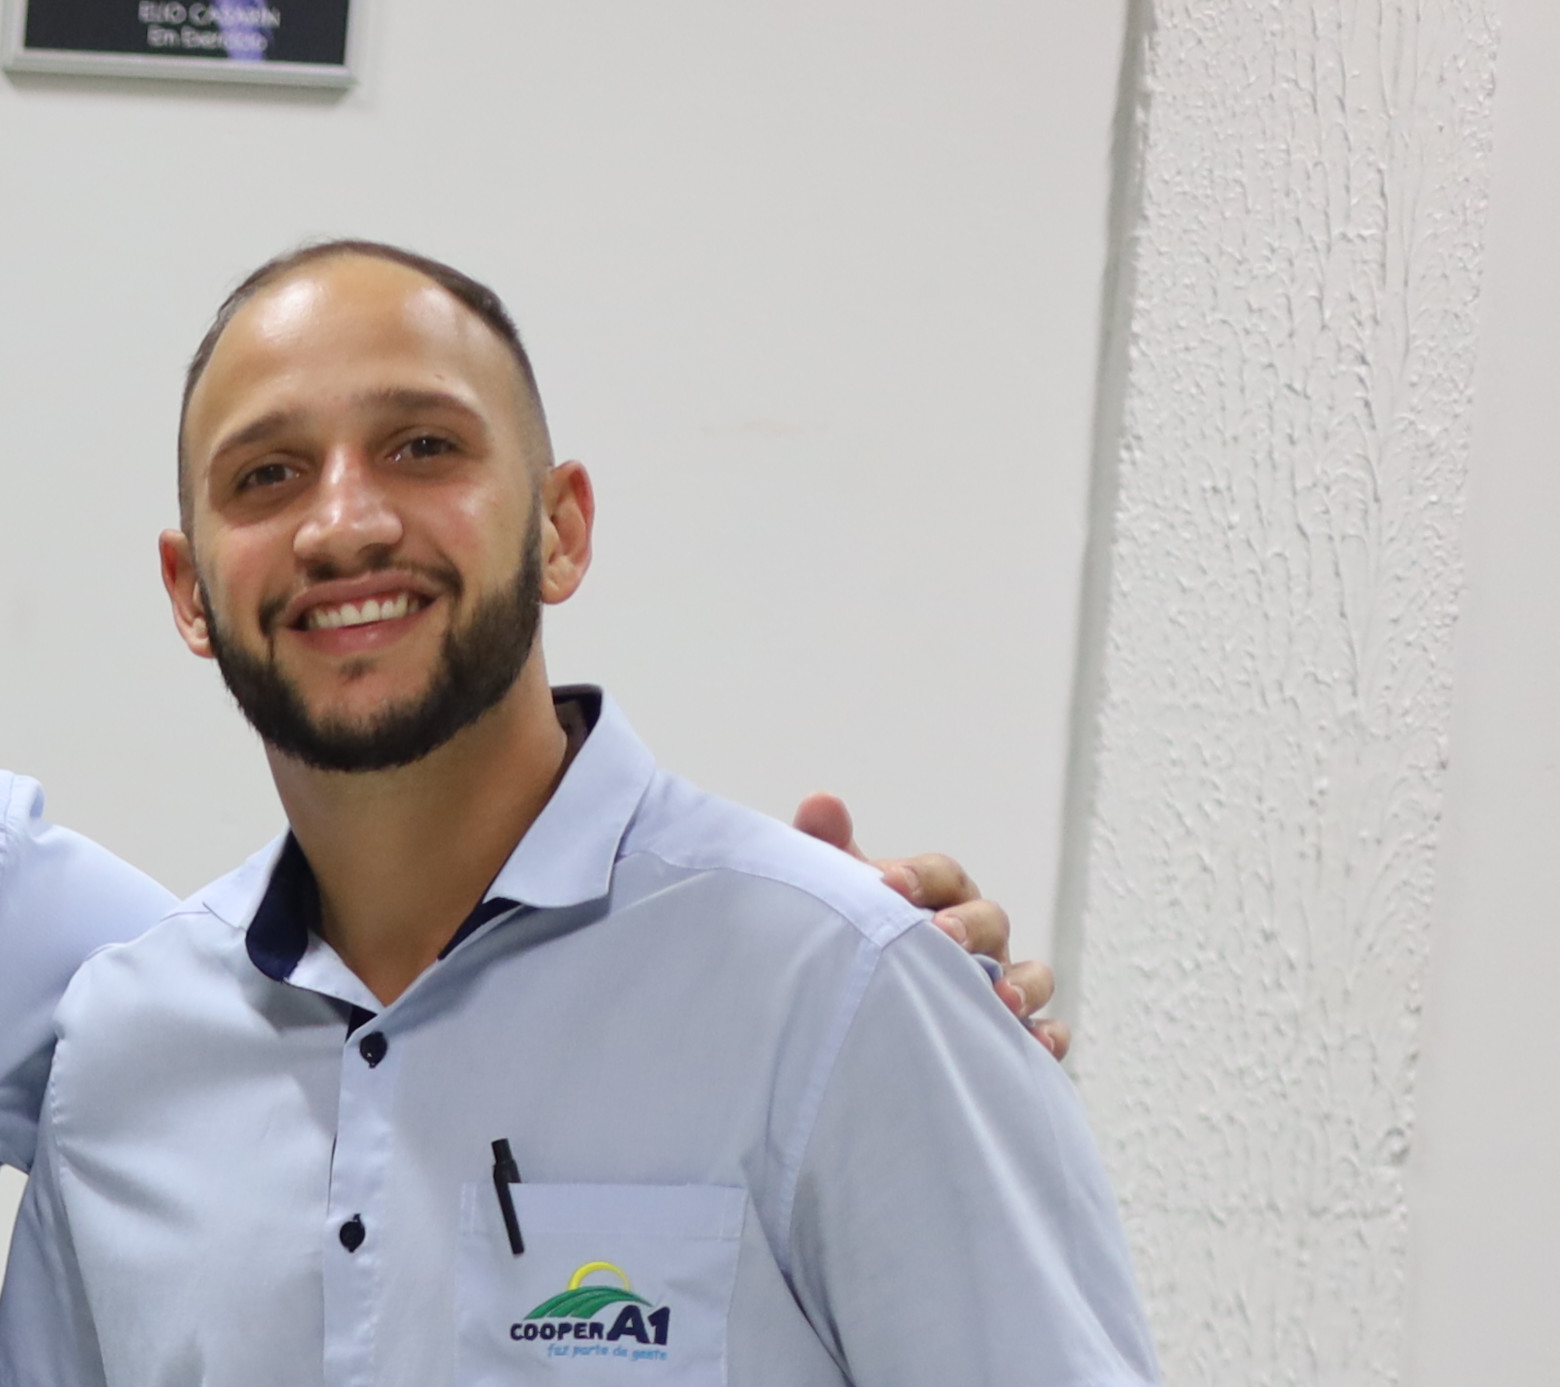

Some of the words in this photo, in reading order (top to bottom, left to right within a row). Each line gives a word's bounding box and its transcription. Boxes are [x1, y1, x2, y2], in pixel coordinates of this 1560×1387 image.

[510, 1322, 604, 1341] COOPER
[606, 1304, 670, 1345] A1
[572, 1344, 607, 1357] parte
